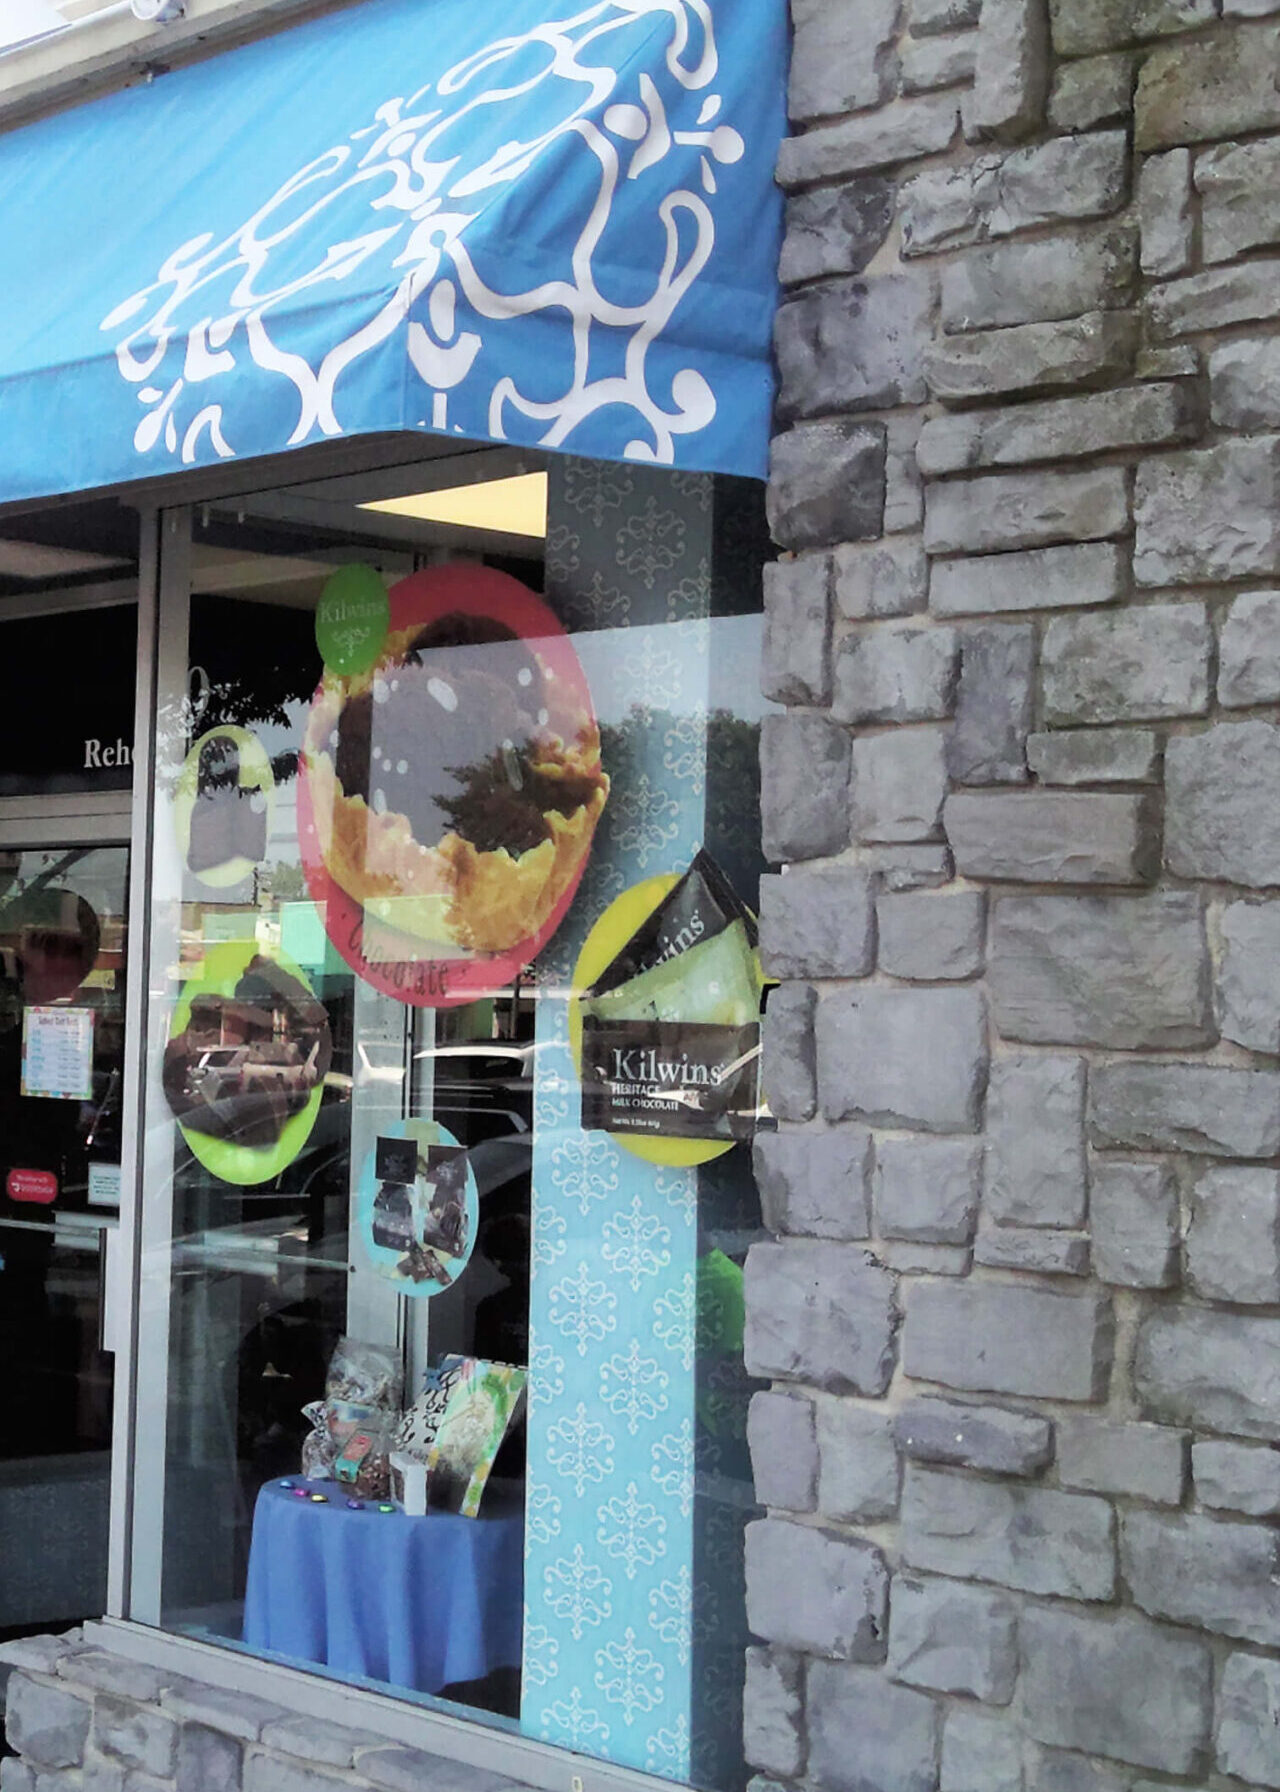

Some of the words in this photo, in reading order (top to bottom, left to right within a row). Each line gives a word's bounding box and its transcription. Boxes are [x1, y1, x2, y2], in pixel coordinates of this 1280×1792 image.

[320, 598, 387, 624] Kilwins
[83, 738, 134, 768] Reh
[612, 1048, 722, 1086] Kilwins
[611, 1083, 661, 1096] HERITAGE
